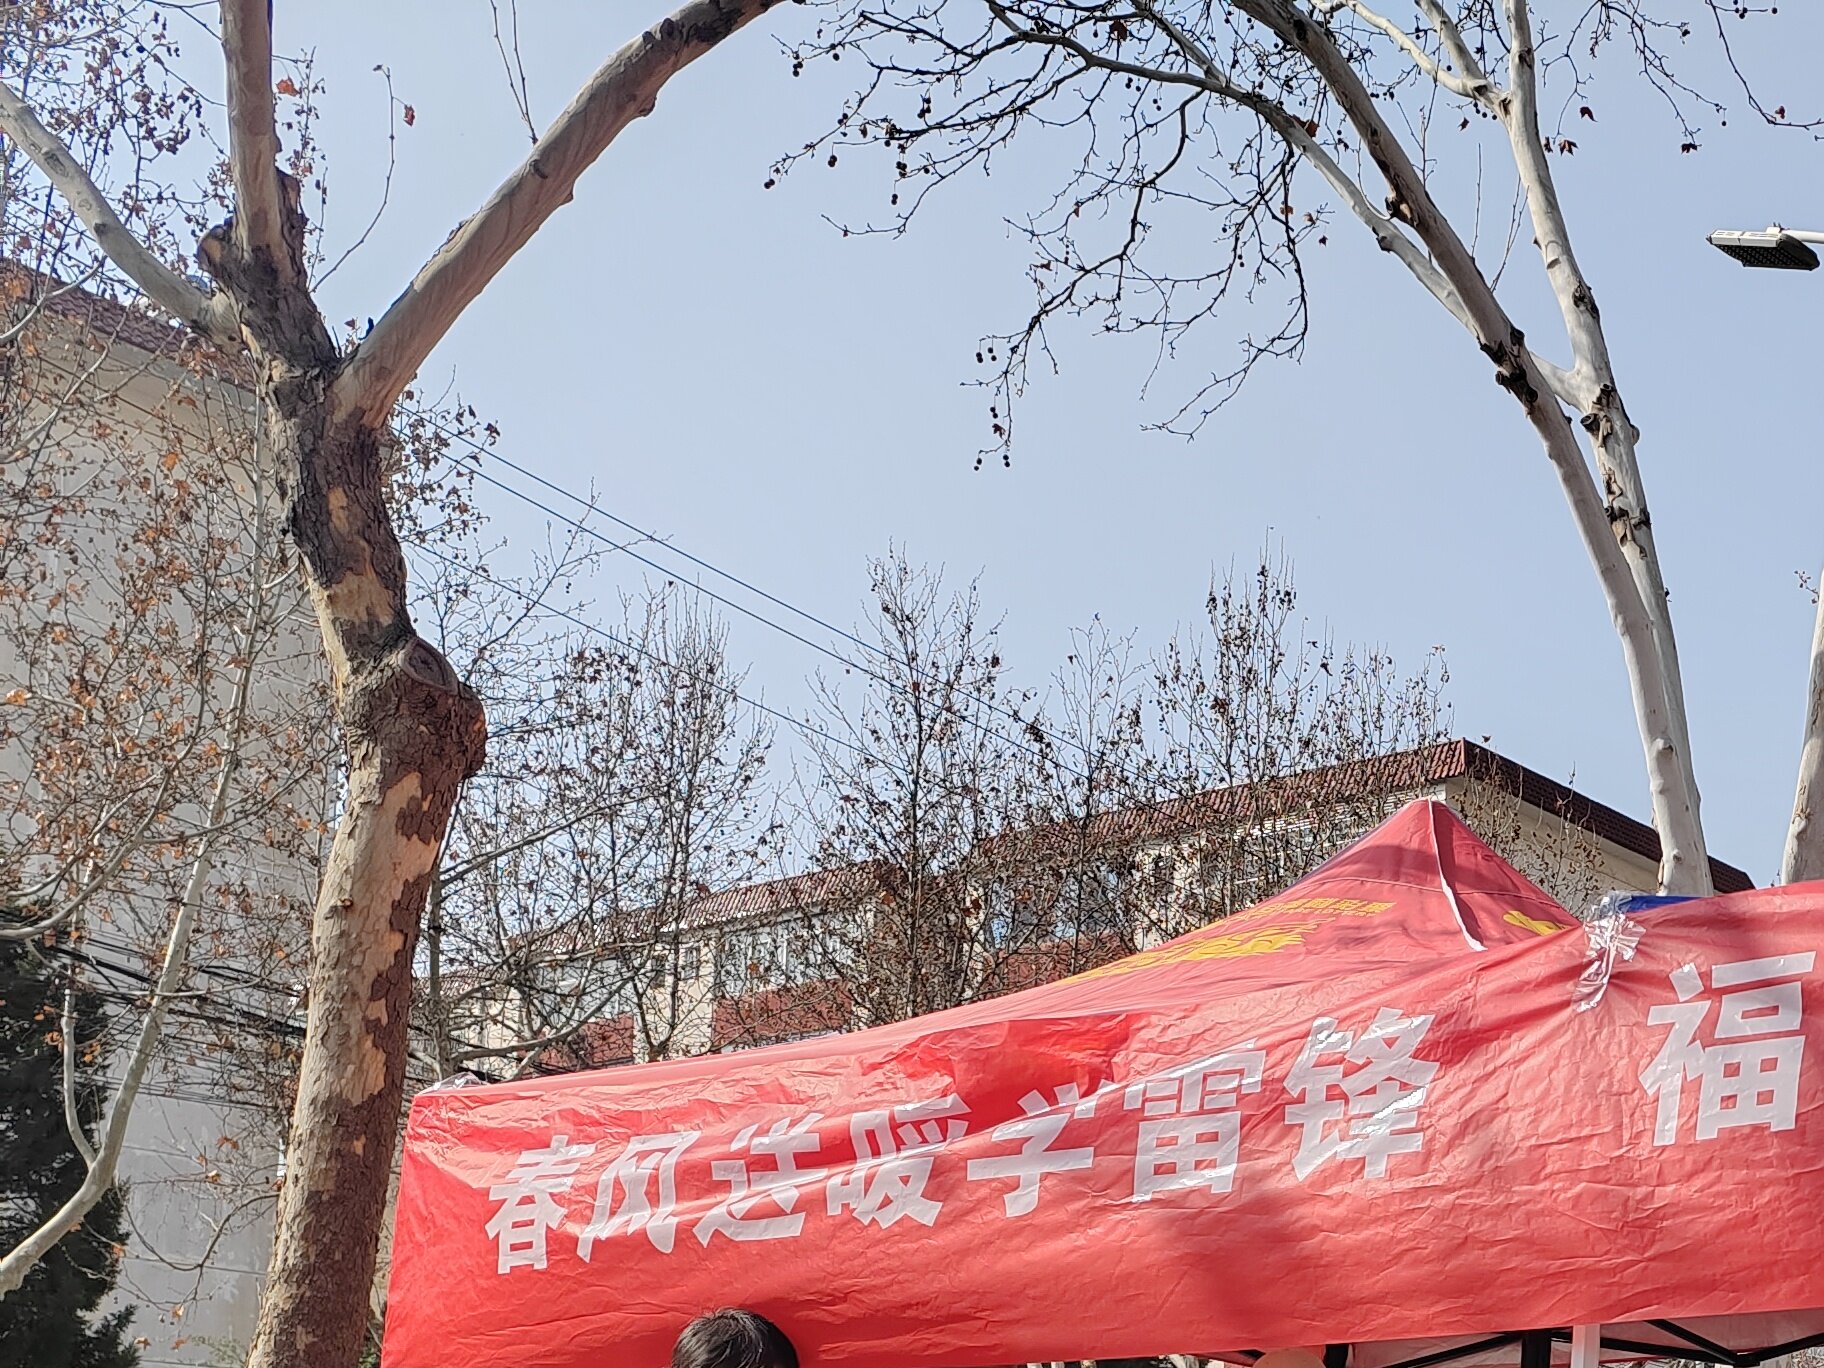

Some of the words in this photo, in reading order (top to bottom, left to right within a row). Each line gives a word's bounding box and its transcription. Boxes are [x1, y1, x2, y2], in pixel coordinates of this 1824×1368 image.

[485, 1006, 1440, 1275] 春风送暖学雷锋
